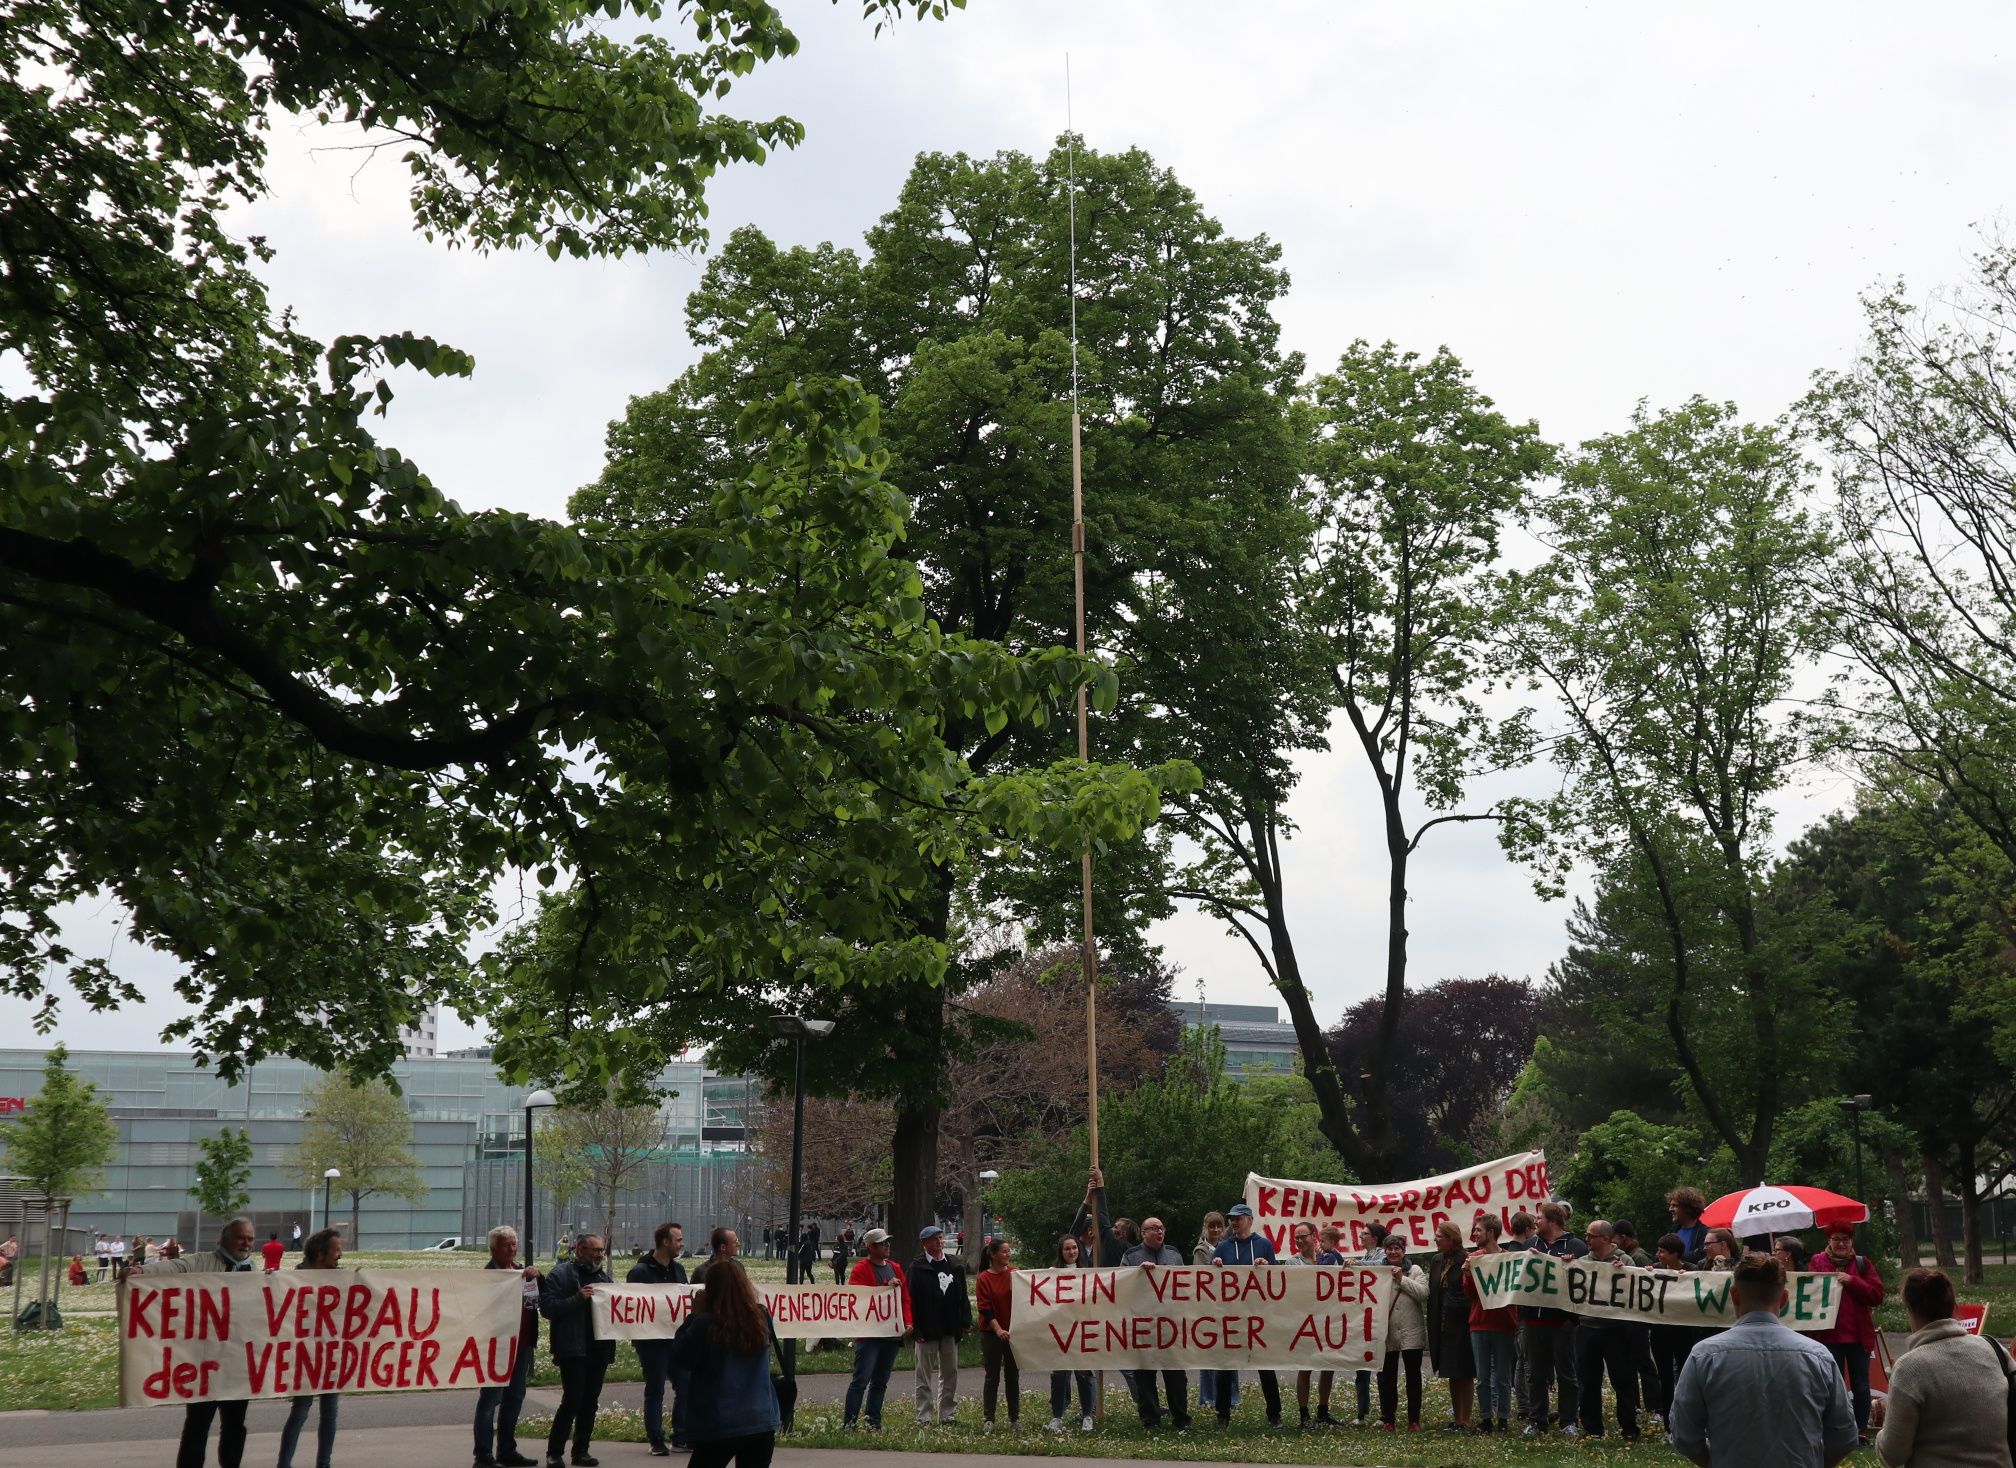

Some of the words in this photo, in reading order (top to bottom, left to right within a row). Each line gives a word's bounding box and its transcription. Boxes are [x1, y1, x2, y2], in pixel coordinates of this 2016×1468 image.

[1258, 1186, 1338, 1217] KEIN
[1351, 1175, 1492, 1215] VERBAU
[1504, 1162, 1550, 1200] DER
[1748, 1200, 1791, 1213] KPÖ
[128, 1287, 230, 1341] KEIN
[262, 1284, 440, 1340] VERBAU
[610, 1294, 656, 1325] KEIN
[765, 1292, 859, 1323] VENEDIGER
[865, 1288, 899, 1333] AU!
[1030, 1271, 1116, 1306] KEIN
[1145, 1269, 1287, 1303] VERBAU
[1316, 1270, 1378, 1304] DER
[1475, 1258, 1559, 1297] WIESE
[1568, 1267, 1679, 1314] BLEIBT
[1049, 1315, 1267, 1354] VENEDIGER
[1289, 1307, 1374, 1362] AU!
[143, 1347, 220, 1399] der
[245, 1340, 441, 1394] VENEDIGER
[448, 1335, 517, 1384] AU
